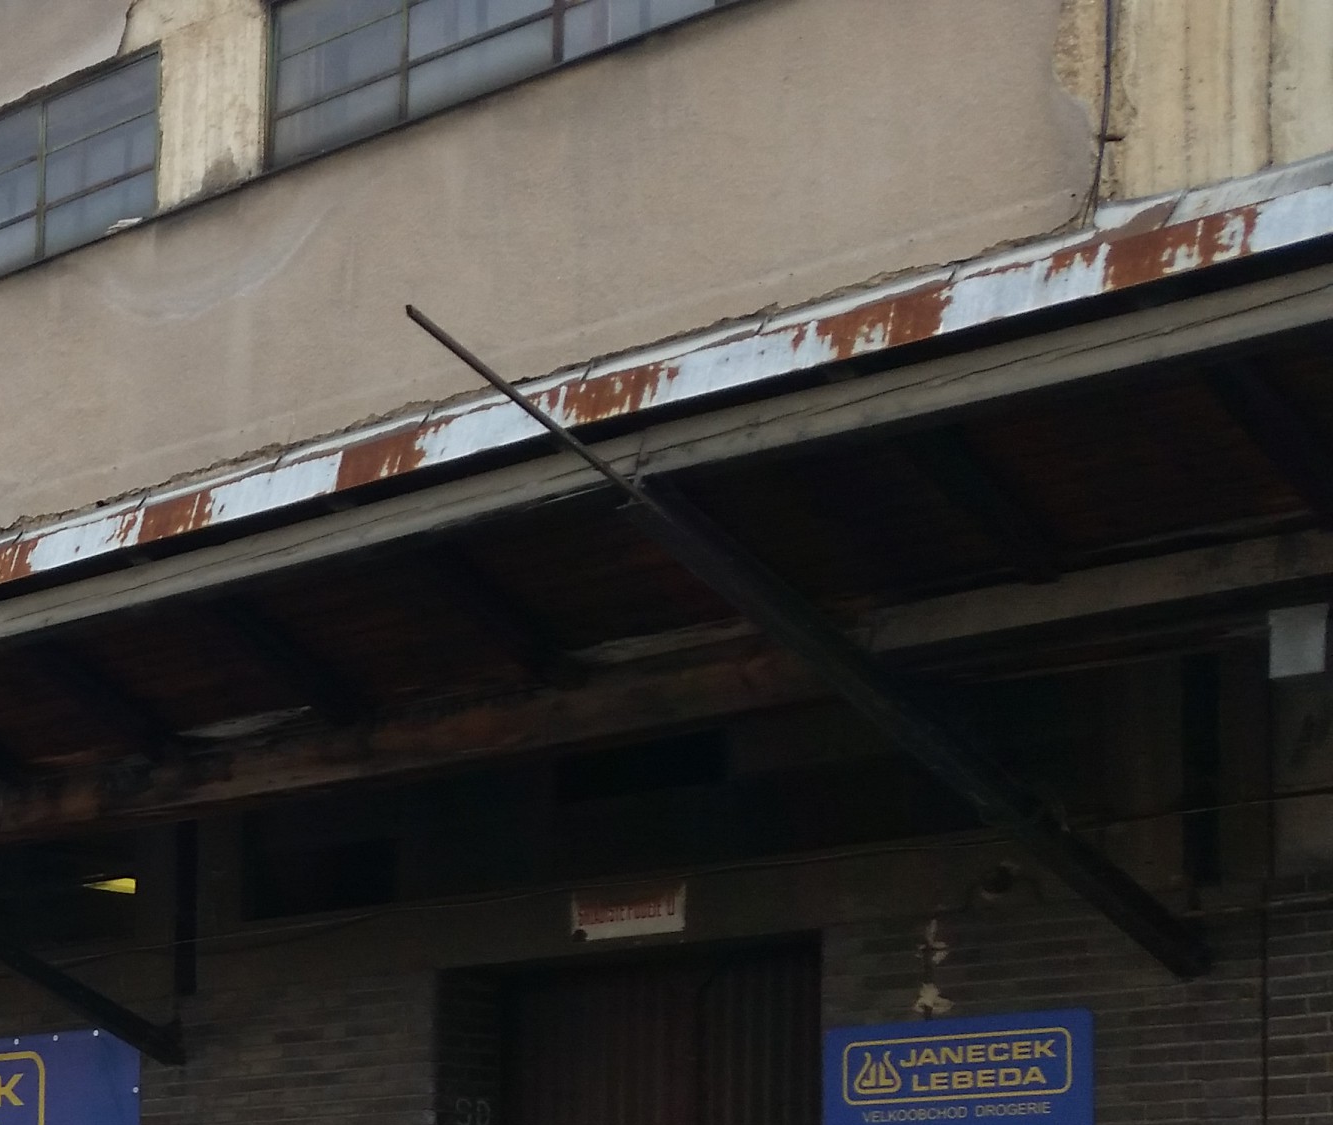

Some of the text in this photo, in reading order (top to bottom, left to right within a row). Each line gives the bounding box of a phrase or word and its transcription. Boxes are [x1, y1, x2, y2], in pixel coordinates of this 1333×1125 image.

[912, 1066, 1047, 1092] LEBEDA
[862, 1101, 1052, 1123] VELKOOBCHOD DROGERIE
